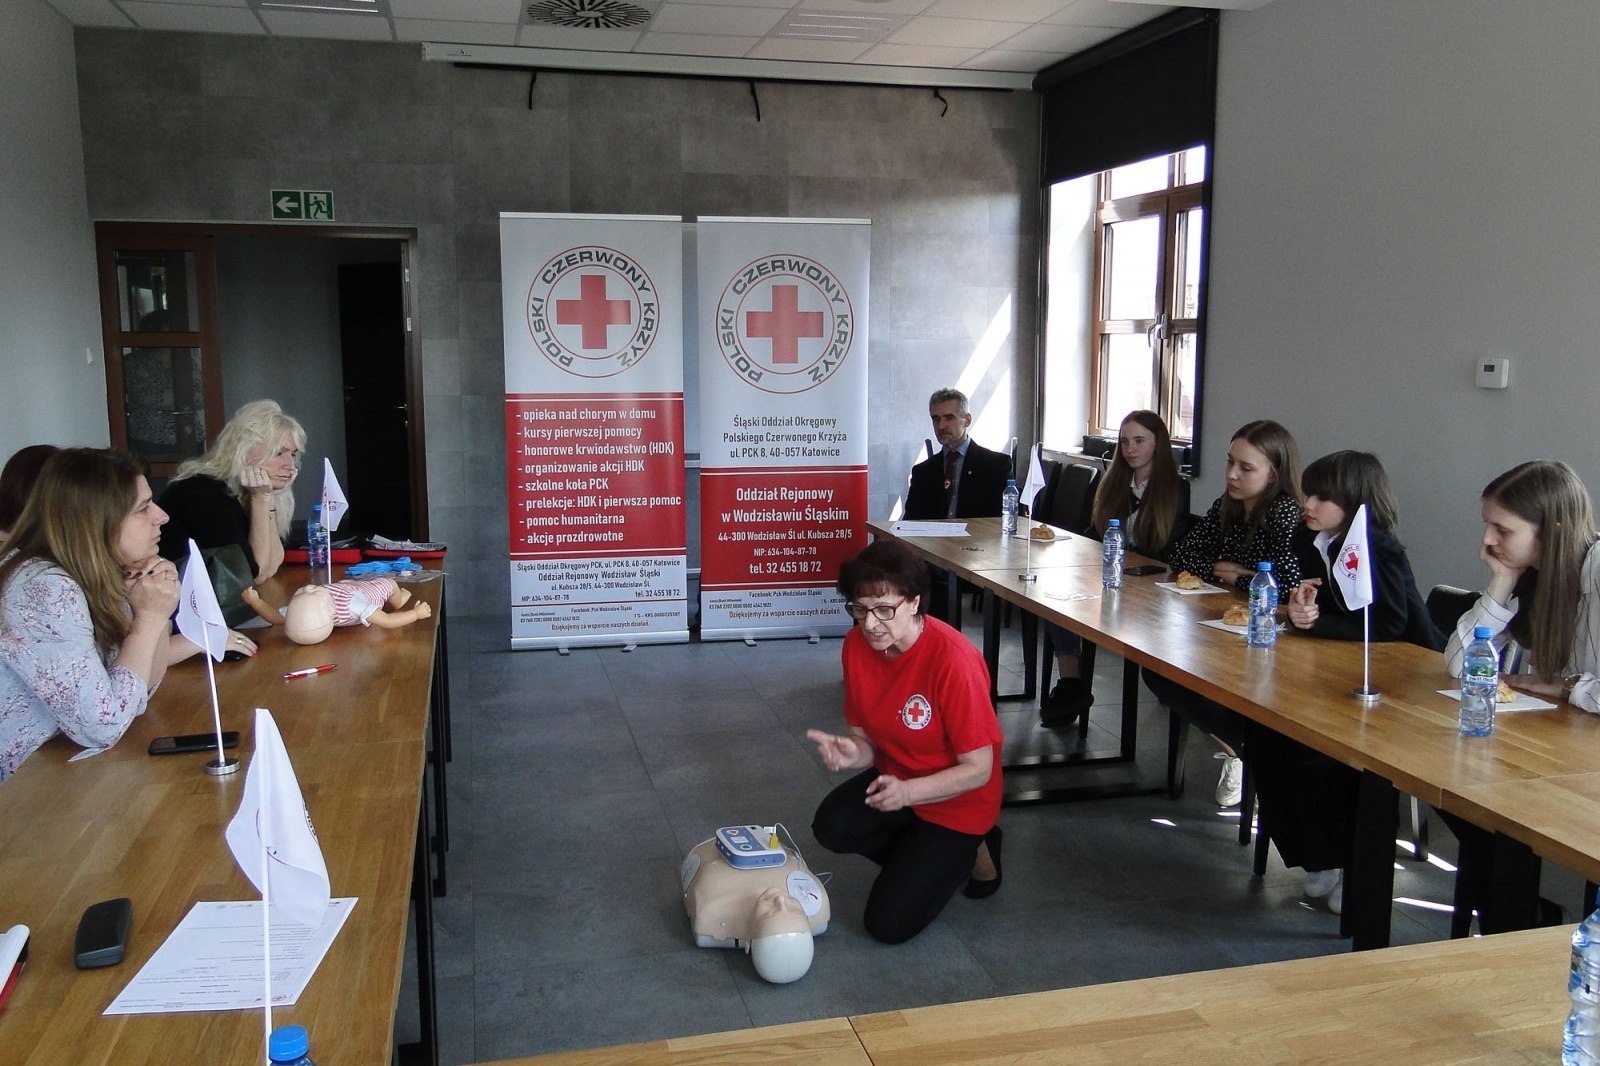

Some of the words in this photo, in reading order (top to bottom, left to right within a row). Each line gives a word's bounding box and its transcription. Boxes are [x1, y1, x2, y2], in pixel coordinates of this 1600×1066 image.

[541, 250, 652, 293] CZERWONY
[732, 258, 845, 304] CZERWONY
[531, 296, 574, 367] POLSKI
[616, 302, 656, 367] KRZYŻ
[720, 308, 764, 383] POLSKI
[807, 313, 849, 383] KRZYŻ
[523, 409, 557, 423] opieka
[558, 408, 578, 420] nad
[579, 408, 617, 422] chorym
[618, 410, 628, 419] w
[629, 408, 656, 419] domu
[733, 414, 760, 429] Śląski
[761, 416, 793, 427] Oddział
[794, 416, 837, 429] Okręgowy
[524, 426, 552, 441] kursy
[554, 426, 603, 440] pierwszej
[604, 426, 642, 439] pomocy
[723, 432, 764, 444] Polskiego
[765, 431, 817, 444] Czerwonego
[818, 430, 847, 443] Krzyża
[524, 444, 574, 456] honorowe
[575, 442, 647, 455] krwiodawstwo
[649, 441, 675, 456] (HDK)
[742, 448, 759, 458] PCK
[760, 447, 768, 458] 8,
[769, 446, 800, 457] 40-057
[801, 446, 840, 457] Katowice
[525, 461, 598, 476] organizowanie
[599, 460, 624, 474] akcji
[625, 459, 645, 471] HDK
[525, 479, 564, 491] szkolne
[565, 478, 587, 490] koła
[589, 478, 609, 490] PCK
[736, 487, 778, 501] Oddział
[780, 487, 834, 503] Rejonowy
[526, 496, 576, 511] prelekcje:
[577, 496, 597, 508] HDK
[603, 495, 648, 510] pierwsza
[649, 496, 682, 509] pomoc
[526, 516, 559, 529] pomoc
[561, 513, 625, 526] humanitarna
[721, 512, 731, 523] w
[733, 508, 803, 522] Wodzisławiu
[804, 504, 849, 523] Śląskim
[527, 532, 554, 546] akcje
[556, 530, 624, 545] prozdrowotne
[718, 531, 746, 542] 44-300
[747, 531, 787, 541] Wodzisław
[797, 530, 806, 540] ul.
[807, 529, 834, 539] Kubsza
[835, 528, 852, 540] 28/5
[753, 548, 767, 557] NIP:
[767, 546, 817, 557] 634-104-87-78
[517, 562, 536, 572] Śląski
[537, 562, 560, 571] Oddział
[560, 562, 590, 571] Okręgowy
[613, 560, 624, 568] PCK
[631, 559, 652, 567] 40-057
[749, 563, 765, 574] tel.
[766, 562, 778, 574] 32
[779, 561, 797, 573] 455
[799, 561, 809, 573] 18
[810, 561, 822, 572] 72
[538, 572, 564, 581] Oddział
[565, 571, 599, 581] Rejonowy
[601, 569, 637, 579] Wodzisław
[639, 567, 661, 579] Śląski
[594, 581, 614, 589] 44-300
[645, 589, 653, 597] 32
[653, 589, 665, 597] 455
[665, 589, 672, 597] 18
[673, 588, 680, 596] 72
[769, 609, 796, 617] wsparcie
[796, 608, 820, 617] naszych
